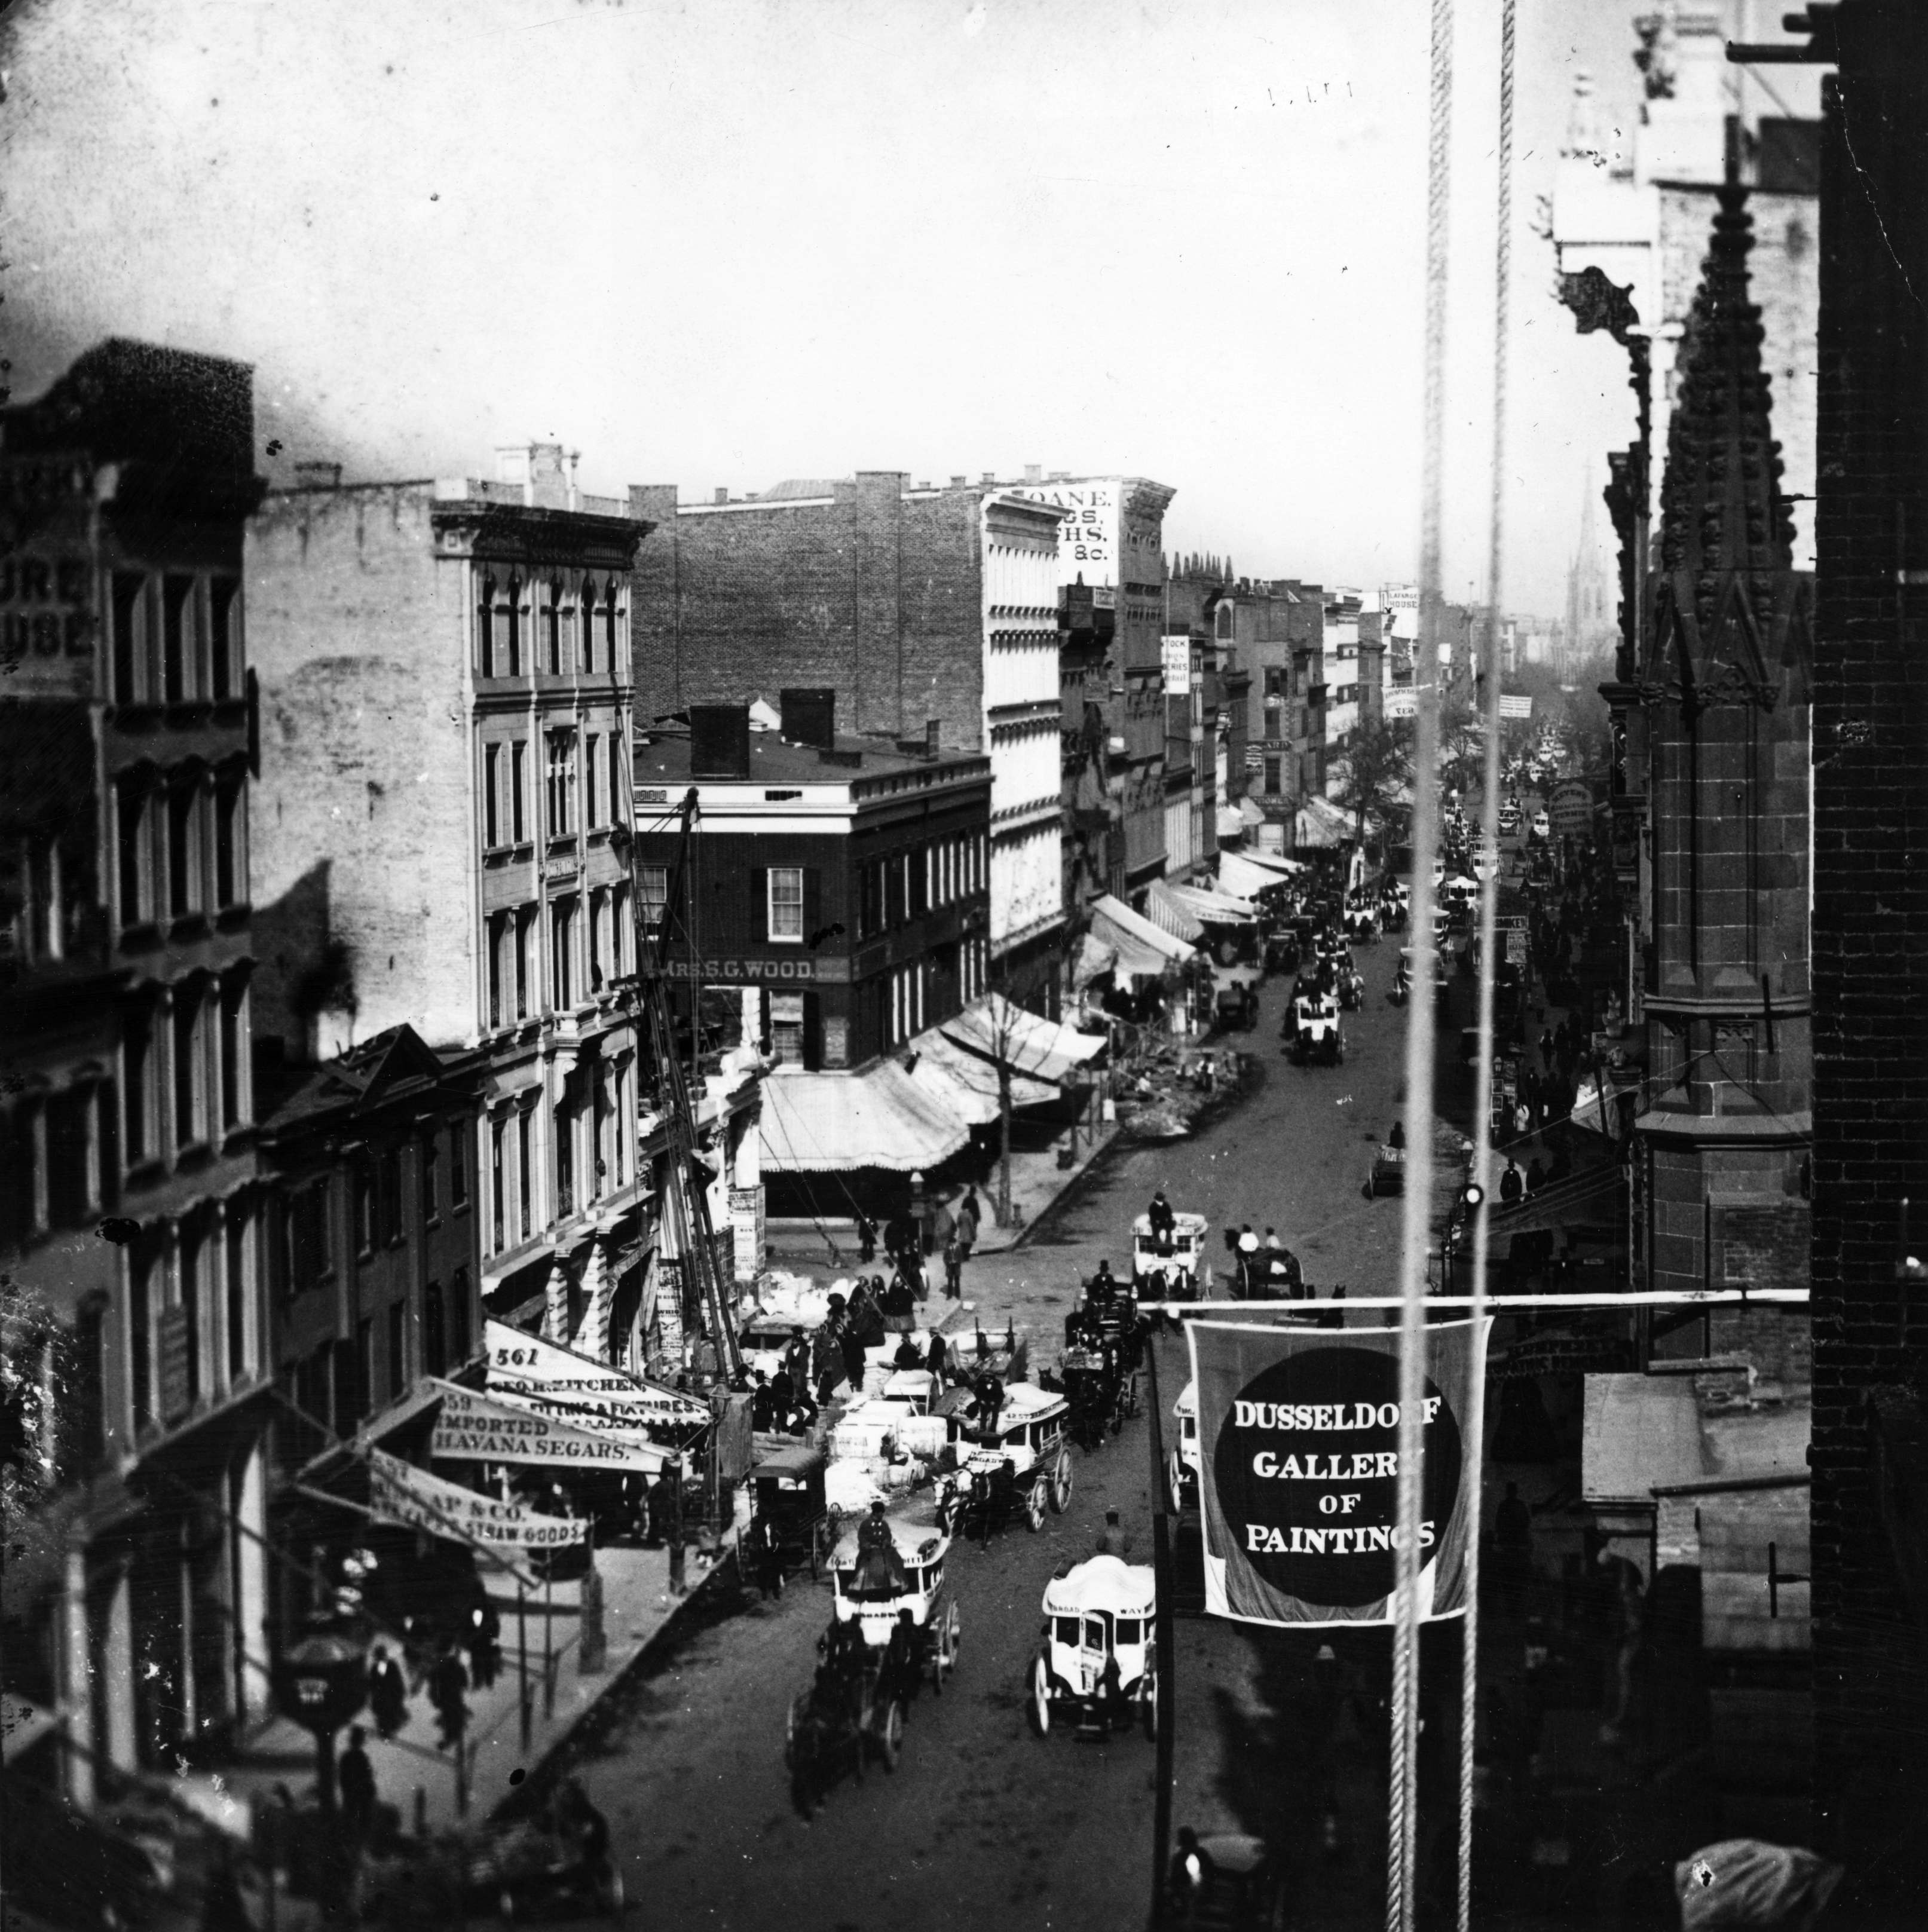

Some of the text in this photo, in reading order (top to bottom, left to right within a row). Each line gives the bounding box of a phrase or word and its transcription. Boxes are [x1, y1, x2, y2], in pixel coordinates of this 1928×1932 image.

[497, 1348, 539, 1366] 561
[443, 1394, 472, 1412] 59
[1234, 1397, 1441, 1430] DUSSELDOF
[436, 1414, 549, 1436] IMPORTED
[436, 1431, 631, 1461] HAVANA SEGARS.
[1253, 1451, 1425, 1480] GALLER
[1318, 1493, 1361, 1514] OF
